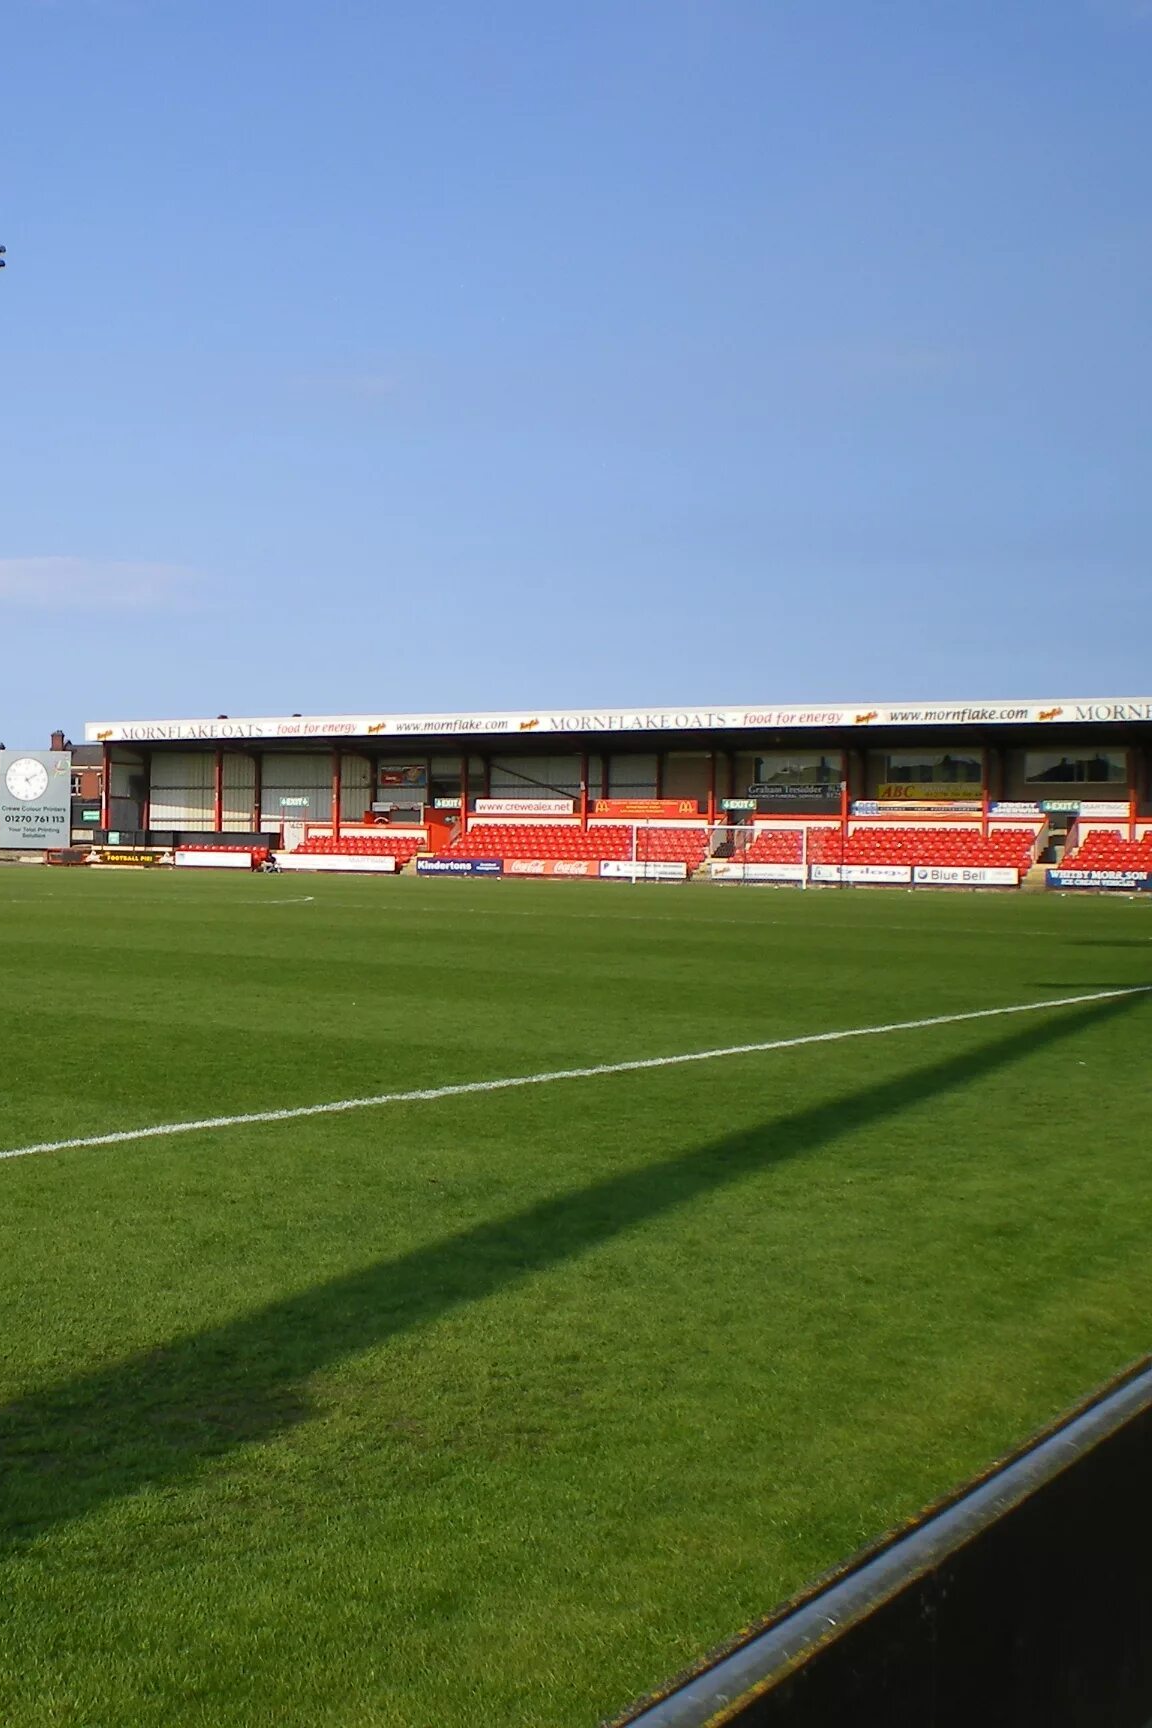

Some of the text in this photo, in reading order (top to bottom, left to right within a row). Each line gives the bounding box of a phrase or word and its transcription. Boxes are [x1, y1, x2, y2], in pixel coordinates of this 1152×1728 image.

[550, 714, 670, 730] MORNFLAKE
[675, 712, 727, 728] OATS
[743, 711, 772, 725] food
[776, 711, 797, 725] for
[799, 711, 844, 725] energy
[889, 708, 1028, 723] www.mornflake.com
[121, 724, 218, 741] MORNFLAKE
[221, 723, 264, 738] OATS
[276, 723, 301, 735] food
[303, 722, 321, 735] for
[322, 722, 359, 734] energy
[396, 719, 509, 732] www.mornflake.com
[881, 786, 915, 798] ABC
[478, 801, 570, 811] www.crewealex.net
[730, 800, 749, 808] EXIT
[1051, 802, 1073, 810] EXIT
[5, 815, 65, 823] 01270 761 113
[417, 860, 472, 871] Kindertons
[930, 869, 958, 881] Blue
[963, 870, 987, 882] Bell
